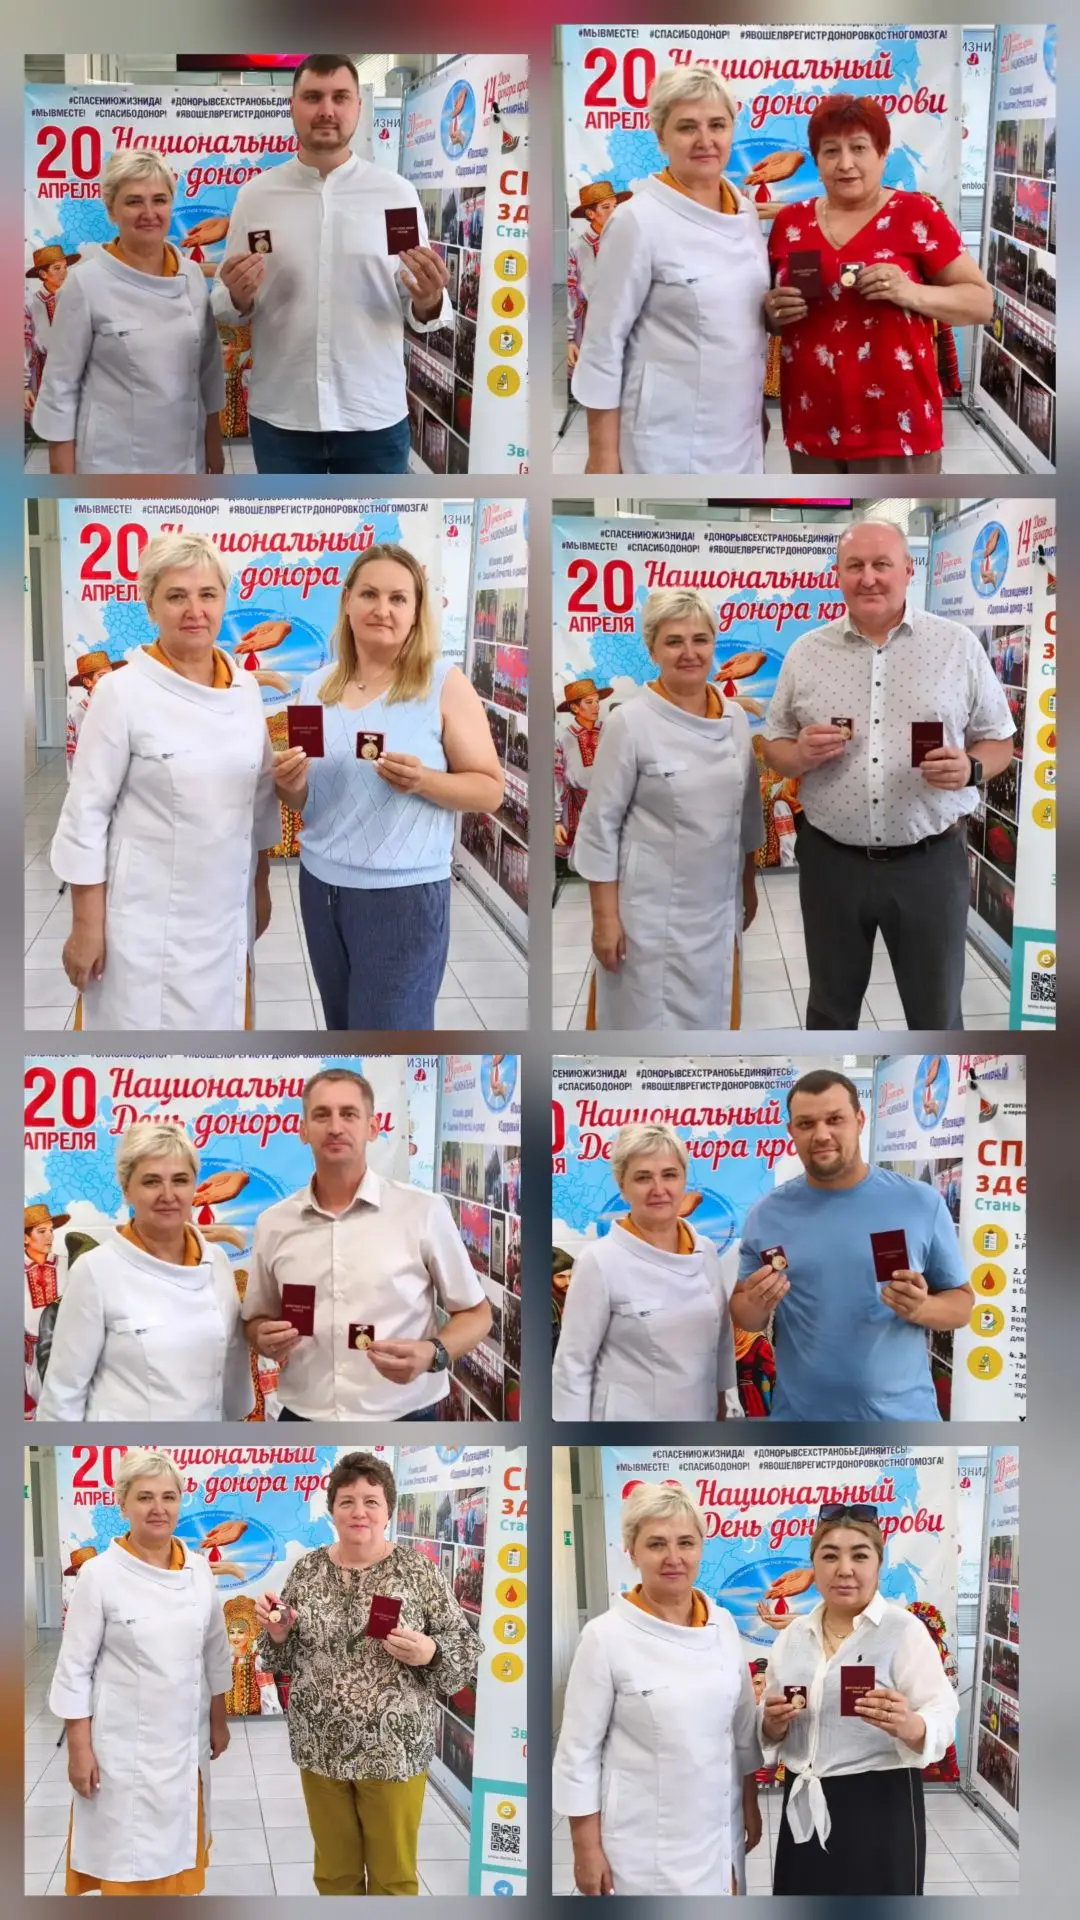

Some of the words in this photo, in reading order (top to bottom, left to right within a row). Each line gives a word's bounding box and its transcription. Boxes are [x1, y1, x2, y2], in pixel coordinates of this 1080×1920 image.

[578, 28, 639, 39] #МЫВМЕСТЕ!
[650, 29, 730, 40] #СПАСИБОДОНОР!
[740, 30, 948, 41] #ЯВОШЕЛВРЕГИСТРДОНОРОВКОСТНОГОМОЗГА!
[584, 48, 655, 108] 20
[69, 96, 162, 107] #СПАСЕНИЮЖИЗНИДА!
[877, 86, 948, 113] рови
[32, 108, 85, 118] #МЫВМЕСТЕ!
[95, 109, 167, 118] #СПАСИБОДОНОР!
[36, 125, 101, 180] 20
[38, 182, 101, 199] АПРЕЛЯ
[74, 504, 132, 515] #МЫВМЕСТЕ!
[142, 505, 219, 515] #СПАСИБОДОНОР!
[229, 503, 428, 516] #ЯВОШЕЛВРЕГИСТРДОНОРОВКОСТНОГОМОЗГА!
[600, 529, 695, 541] #СПАСЕНИЮЖИЗНИДА!
[80, 523, 148, 581] 20
[562, 541, 618, 551] #МЫВМЕСТЕ!
[627, 543, 700, 553] #СПАСИБОДОНОР!
[239, 565, 340, 600] донора
[568, 559, 633, 614] 20
[81, 584, 142, 602] АПРЕЛ
[569, 617, 633, 632] АПРЕЛЯ
[719, 602, 811, 632] донора
[558, 1082, 632, 1091] #СПАСИБОДОНОР!
[24, 1067, 96, 1128] 20
[576, 1099, 782, 1127] Национальный
[194, 1114, 299, 1148] донора
[24, 1132, 95, 1149] АПРЕЛЯ
[977, 1139, 1026, 1167] СП
[974, 1198, 1021, 1212] Стань
[653, 1449, 745, 1459] #СПАСЕНИЮЖИЗНИДА!
[616, 1463, 669, 1472] #МЫВМЕСТЕ!
[679, 1462, 750, 1472] #СПАСИБОДОНОР!
[759, 1457, 944, 1471] #ЯВОШЕЛВРЕГИСТРДОНОРОВКОСТНОГОМОЗГА!
[205, 1475, 288, 1503] донора
[696, 1477, 896, 1512] Национальный
[501, 1519, 527, 1531] Ста
[704, 1511, 762, 1538] День
[879, 1508, 945, 1545] рови
